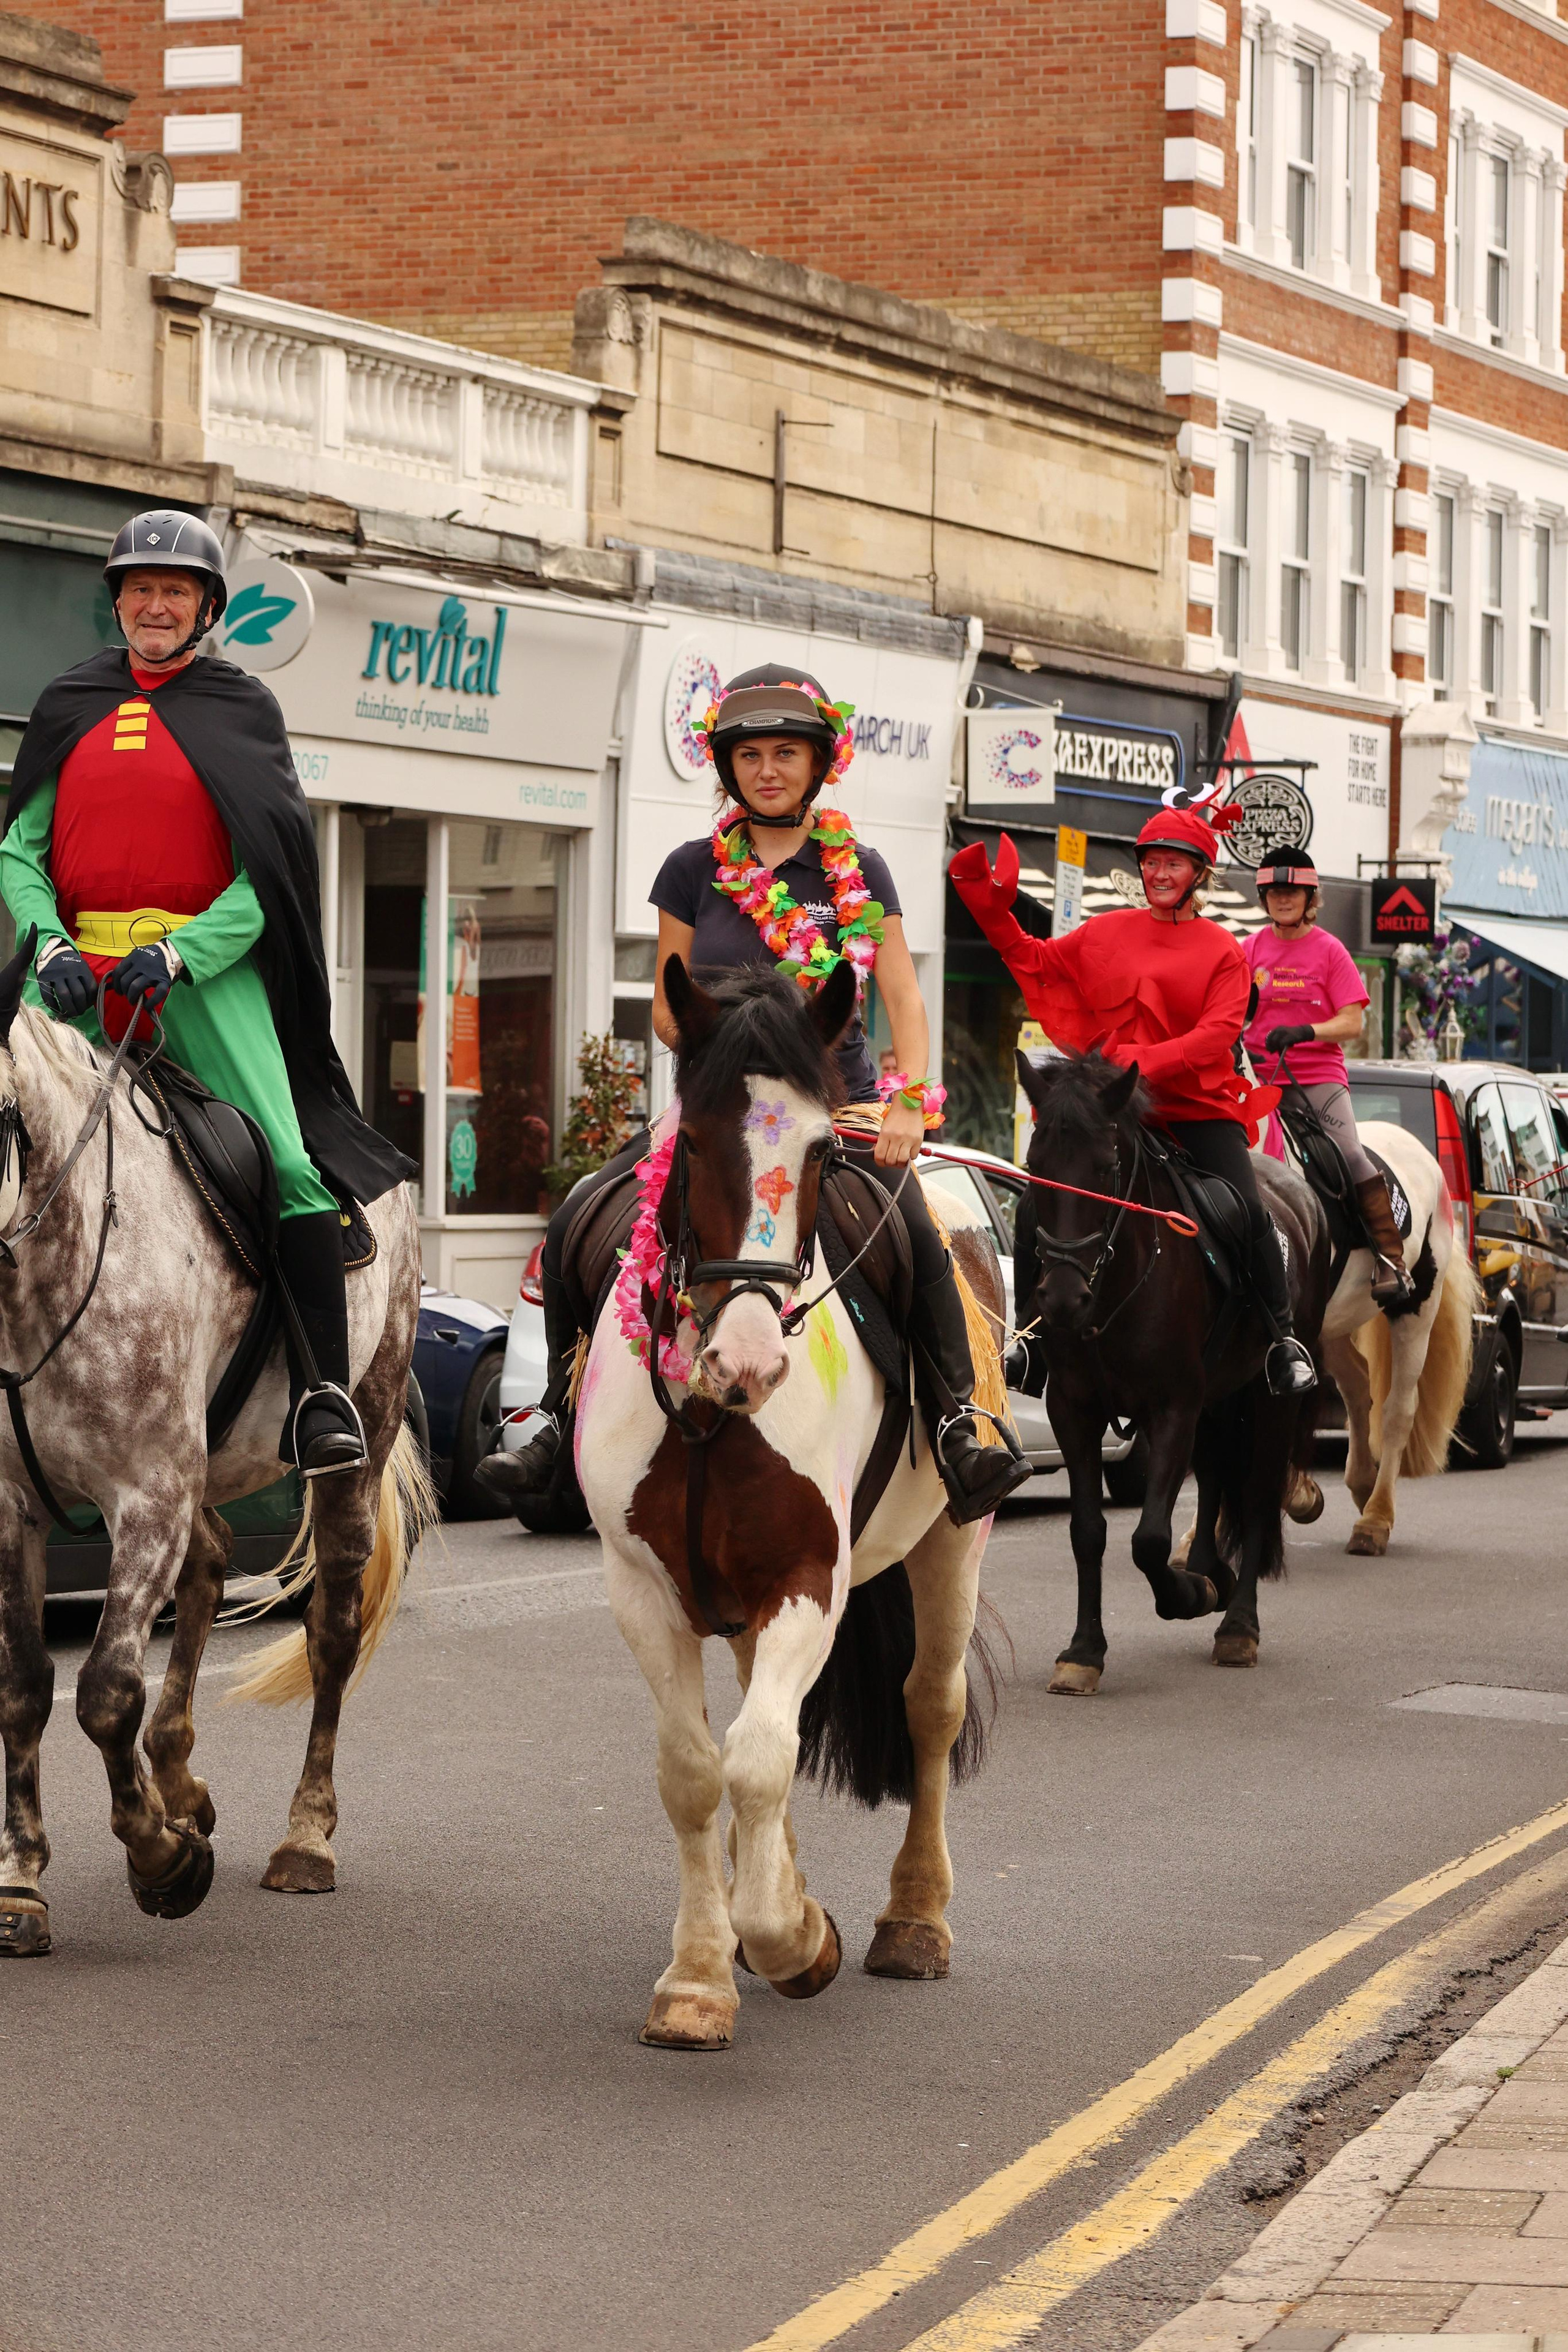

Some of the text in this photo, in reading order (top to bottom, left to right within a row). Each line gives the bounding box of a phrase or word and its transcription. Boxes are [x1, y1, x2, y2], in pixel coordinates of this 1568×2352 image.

[1, 171, 78, 251] NTS
[361, 606, 508, 696] revital
[356, 692, 489, 734] thinking of your health
[908, 722, 932, 760] UK
[1349, 733, 1378, 758] THE FIGHT
[1348, 758, 1377, 782] FOR HOME
[519, 781, 587, 810] revital.com
[1348, 783, 1387, 809] STARTS HERE
[1233, 819, 1301, 832] EXPRESS
[1245, 808, 1288, 822] PIZZA
[1485, 792, 1555, 856] megan's
[1376, 916, 1430, 932] SHELTER
[1273, 979, 1305, 988] Research
[1293, 973, 1319, 982] Tumour
[455, 1133, 472, 1159] 30
